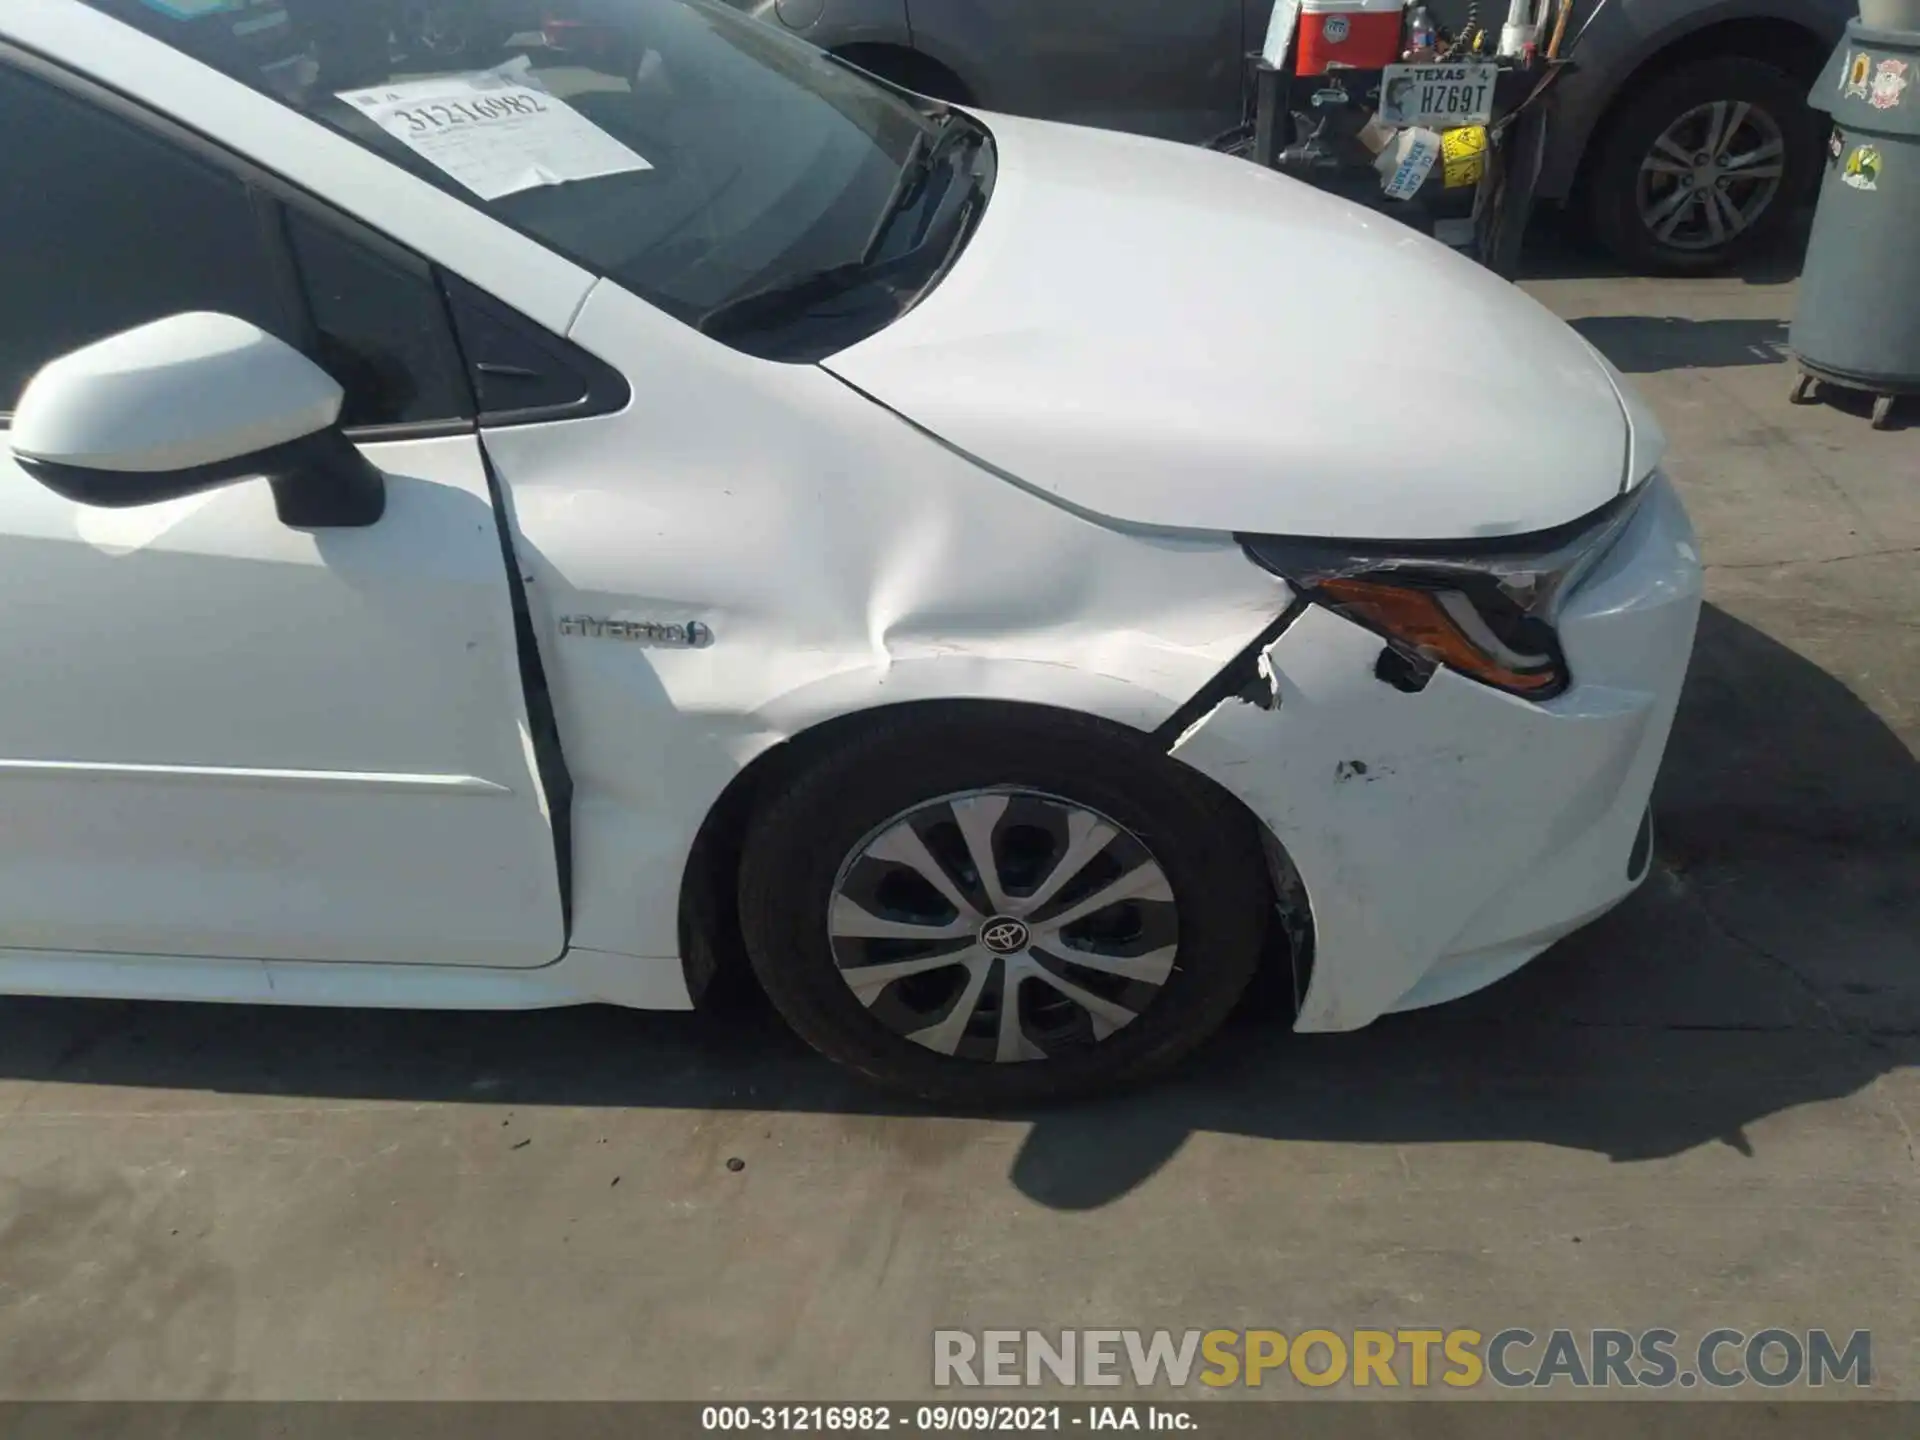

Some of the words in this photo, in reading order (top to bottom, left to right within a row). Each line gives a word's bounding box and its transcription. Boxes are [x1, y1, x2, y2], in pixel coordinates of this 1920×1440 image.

[1415, 69, 1466, 81] TEXAS
[394, 94, 547, 131] 31216982
[1420, 85, 1487, 113] HZ69T
